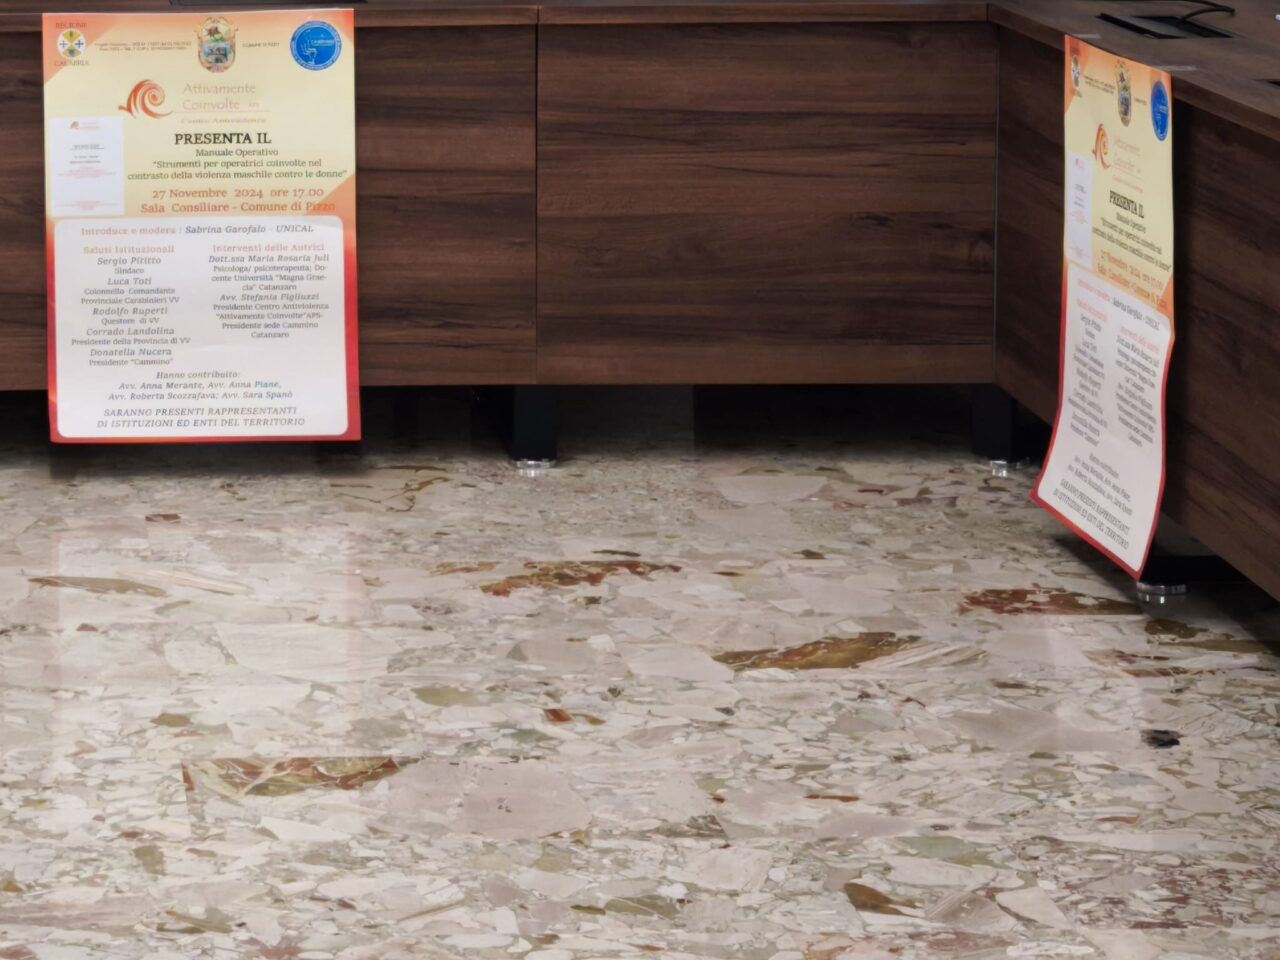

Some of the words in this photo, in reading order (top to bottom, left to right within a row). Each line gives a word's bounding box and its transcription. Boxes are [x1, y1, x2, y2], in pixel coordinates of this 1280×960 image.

[183, 83, 256, 94] Attivamente
[182, 98, 240, 110] Coinvolte
[174, 133, 253, 145] PRESENTA
[256, 132, 272, 144] IL
[195, 148, 233, 156] Manuale
[235, 147, 278, 158] Operativo
[203, 161, 218, 169] per
[220, 159, 264, 169] operatrici
[265, 158, 306, 167] coinvolte
[308, 158, 322, 167] nel
[127, 171, 169, 179] contrasto
[171, 171, 193, 179] della
[195, 170, 232, 179] violenza
[233, 170, 272, 179] maschile
[274, 170, 303, 178] contro
[305, 170, 314, 178] le
[152, 191, 166, 200] 27
[169, 188, 227, 198] Novembre
[234, 190, 263, 199] 2024
[140, 203, 165, 213] Sala
[171, 202, 229, 212] Consiliare
[240, 202, 287, 212] Comune
[290, 202, 302, 211] di
[305, 201, 336, 211] Pizzo
[140, 226, 176, 234] modera
[184, 225, 223, 234] Sabrina
[225, 225, 266, 233] Garofalo
[275, 224, 314, 233] UNICAL
